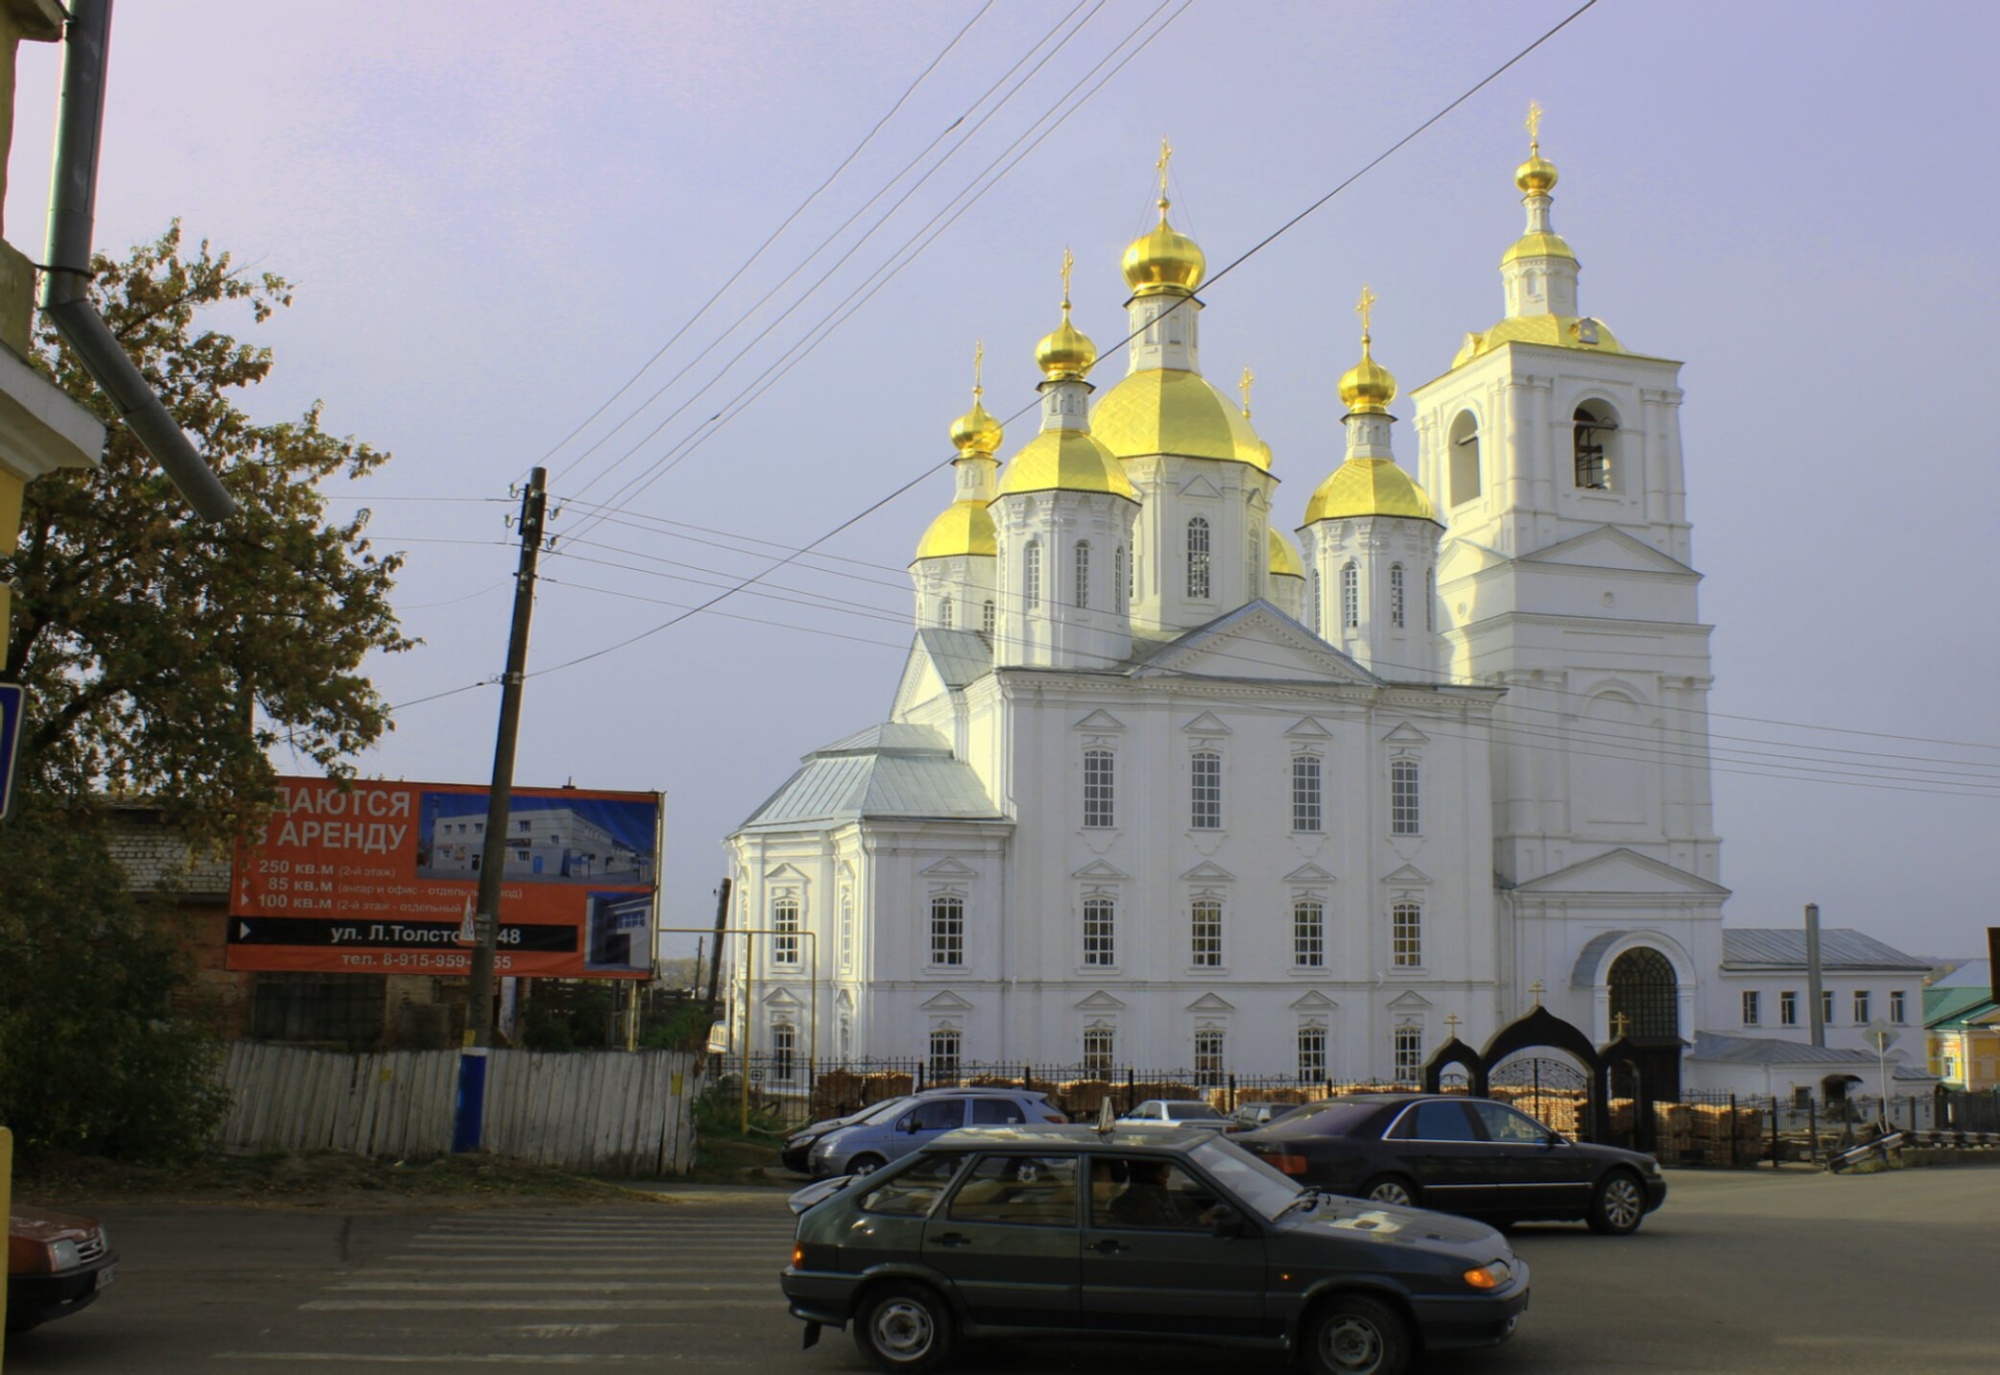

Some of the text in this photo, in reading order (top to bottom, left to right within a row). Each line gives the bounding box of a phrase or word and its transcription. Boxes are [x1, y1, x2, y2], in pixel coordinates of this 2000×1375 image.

[268, 787, 411, 818] ДАЮТСЯ
[277, 820, 407, 854] АРЕНДУ
[259, 860, 290, 874] 250
[295, 863, 334, 875] кв.м
[268, 877, 289, 891] 85
[294, 881, 333, 892] кв.м
[387, 886, 417, 898] офис
[257, 894, 288, 909] 100
[293, 898, 332, 910] кв.м
[400, 902, 461, 914] отдельный
[331, 926, 362, 943] ул.
[497, 928, 521, 944] 48
[342, 953, 512, 969] тел. 8-915-959-55
